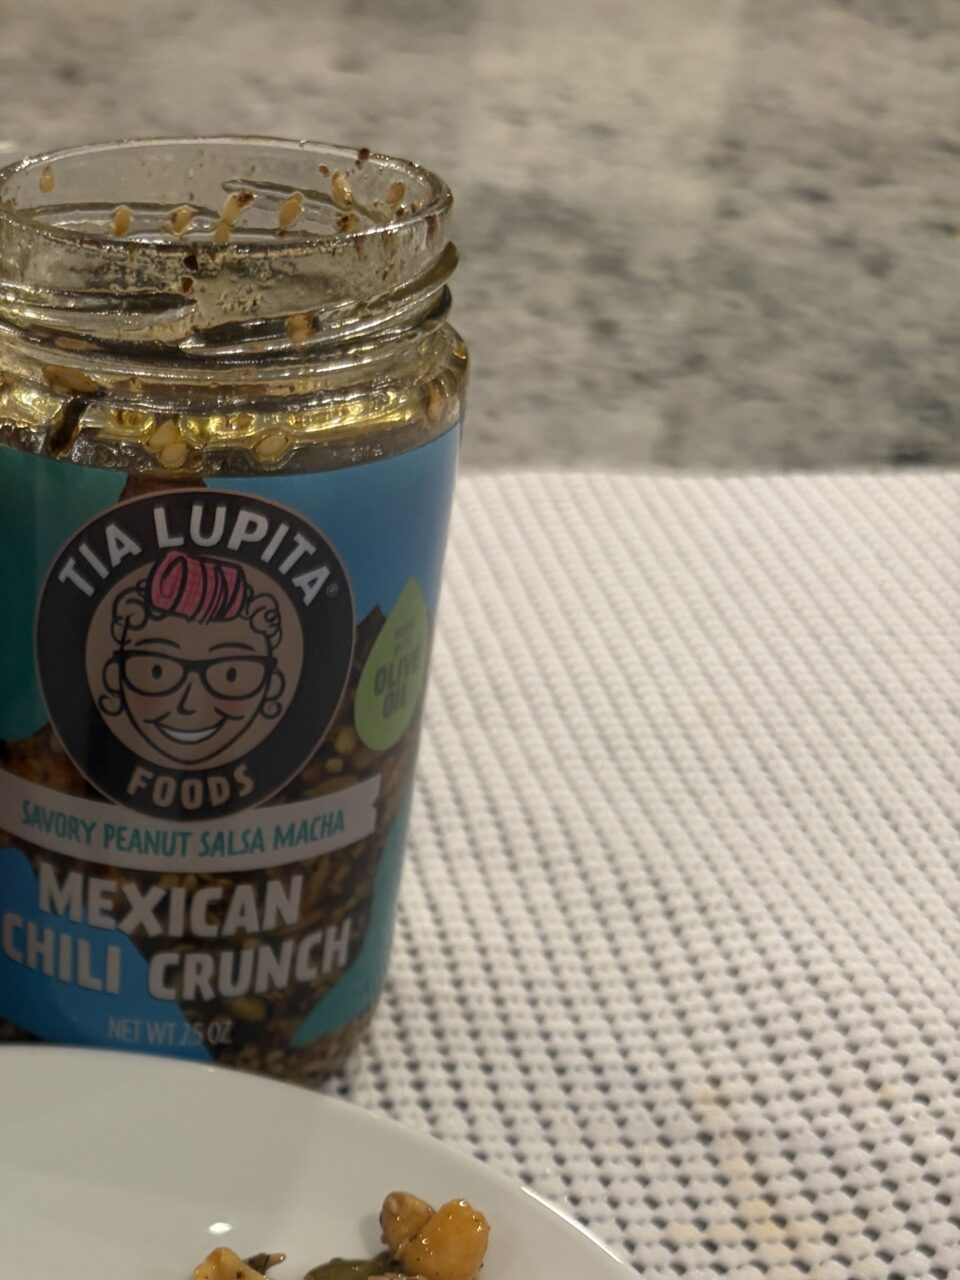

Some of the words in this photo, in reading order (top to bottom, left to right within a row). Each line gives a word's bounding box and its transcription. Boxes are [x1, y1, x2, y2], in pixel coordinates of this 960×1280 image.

[58, 523, 143, 597] TIA
[153, 504, 334, 606] LUPITA
[126, 763, 254, 810] FOODS
[21, 801, 96, 845] SAVORY
[103, 823, 191, 857] PEANUT
[198, 828, 265, 857] SALSA
[274, 810, 345, 849] MACHA
[39, 862, 303, 938] MEXICAN
[2, 911, 121, 995] CHILI
[147, 918, 351, 1001] CRUNCH
[107, 1016, 141, 1043] NET
[145, 1021, 176, 1046] WT
[206, 1019, 234, 1045] OZ
